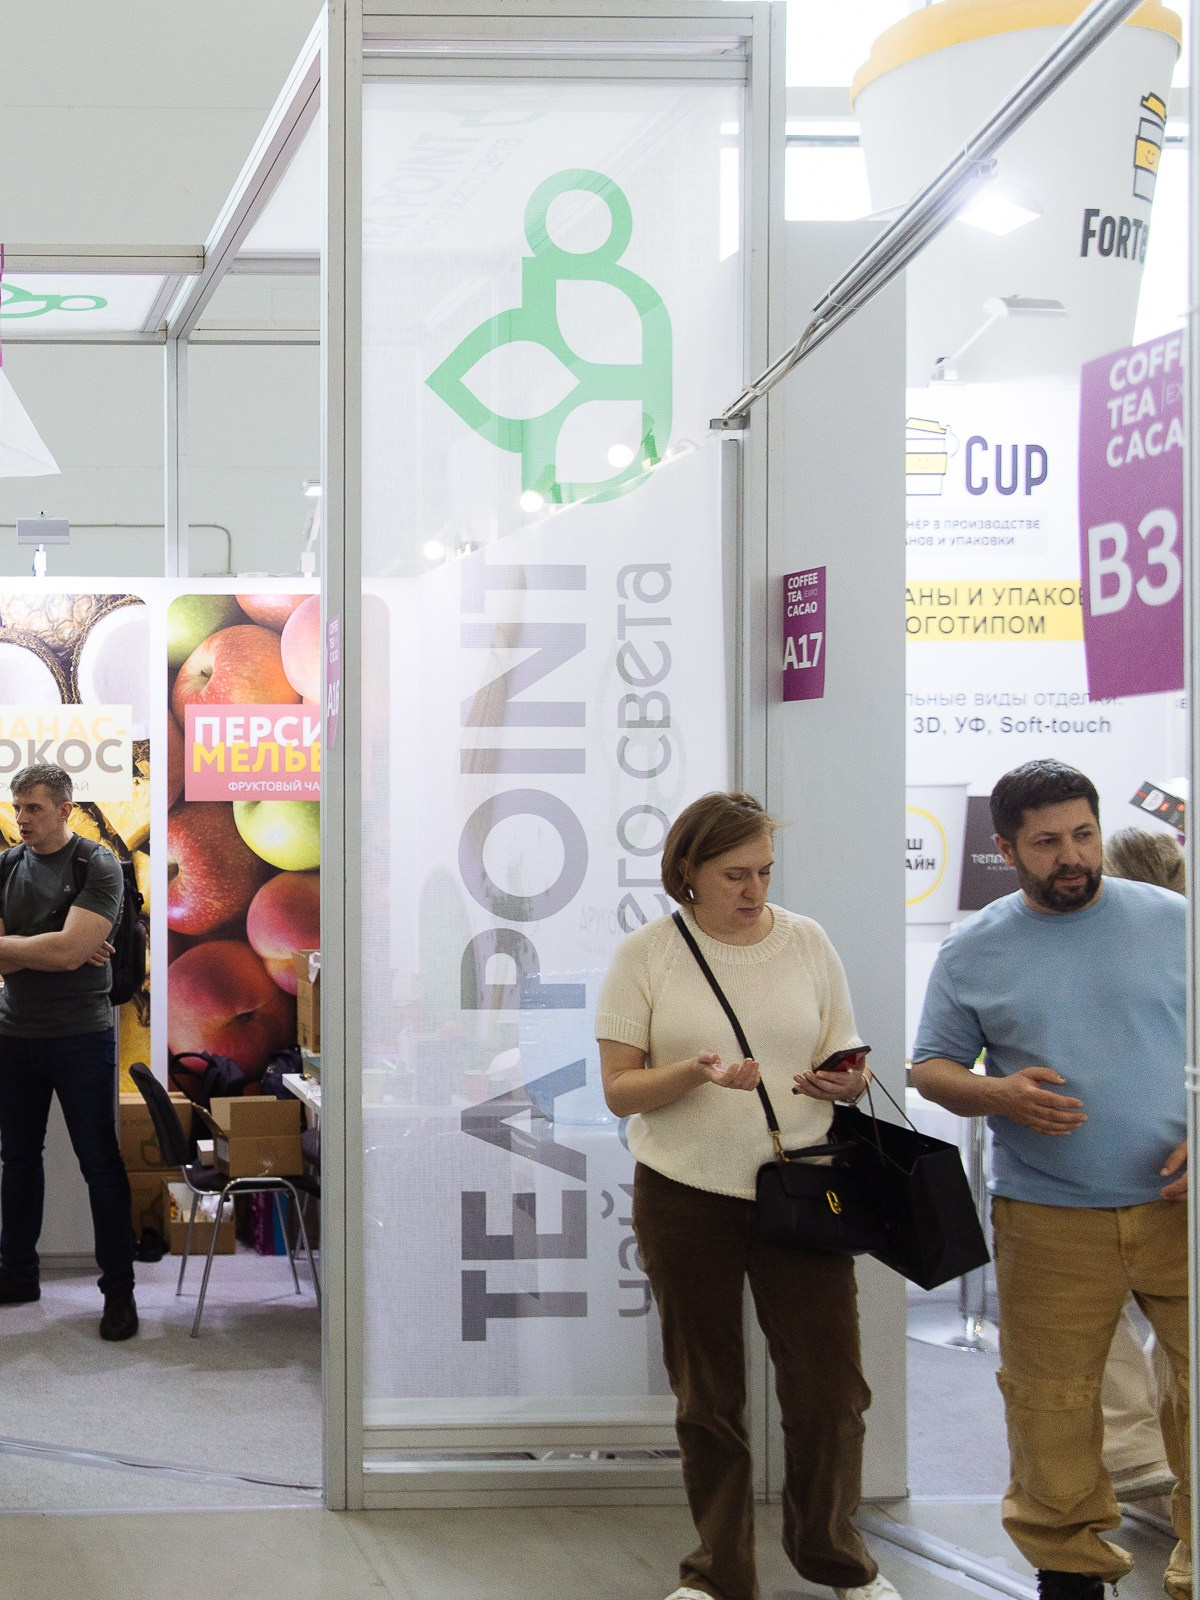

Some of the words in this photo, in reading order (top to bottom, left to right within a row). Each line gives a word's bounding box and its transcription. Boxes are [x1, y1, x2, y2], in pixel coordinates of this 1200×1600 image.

[1106, 386, 1157, 430] TEA
[944, 519, 1040, 531] ПРОИЗВОДСТВЕ
[950, 536, 1016, 546] УПАКОВКИ
[787, 572, 819, 590] COFFEE
[787, 590, 803, 603] TEA
[804, 588, 818, 598] EXPO
[968, 587, 983, 606] И
[787, 601, 818, 617] CACAO
[905, 615, 1046, 634] ОГОТИПОМ
[782, 631, 823, 671] A17
[616, 562, 673, 780] света
[974, 692, 1026, 708] виды
[194, 715, 320, 748] ПЕРСИ
[912, 716, 946, 735] 3D,
[954, 716, 992, 735] УФ,
[1000, 716, 1111, 734] Soft-touch
[458, 541, 589, 1010] POINT
[227, 780, 300, 792] ФРУКТОВЫЙ
[461, 1057, 587, 1341] TEA
